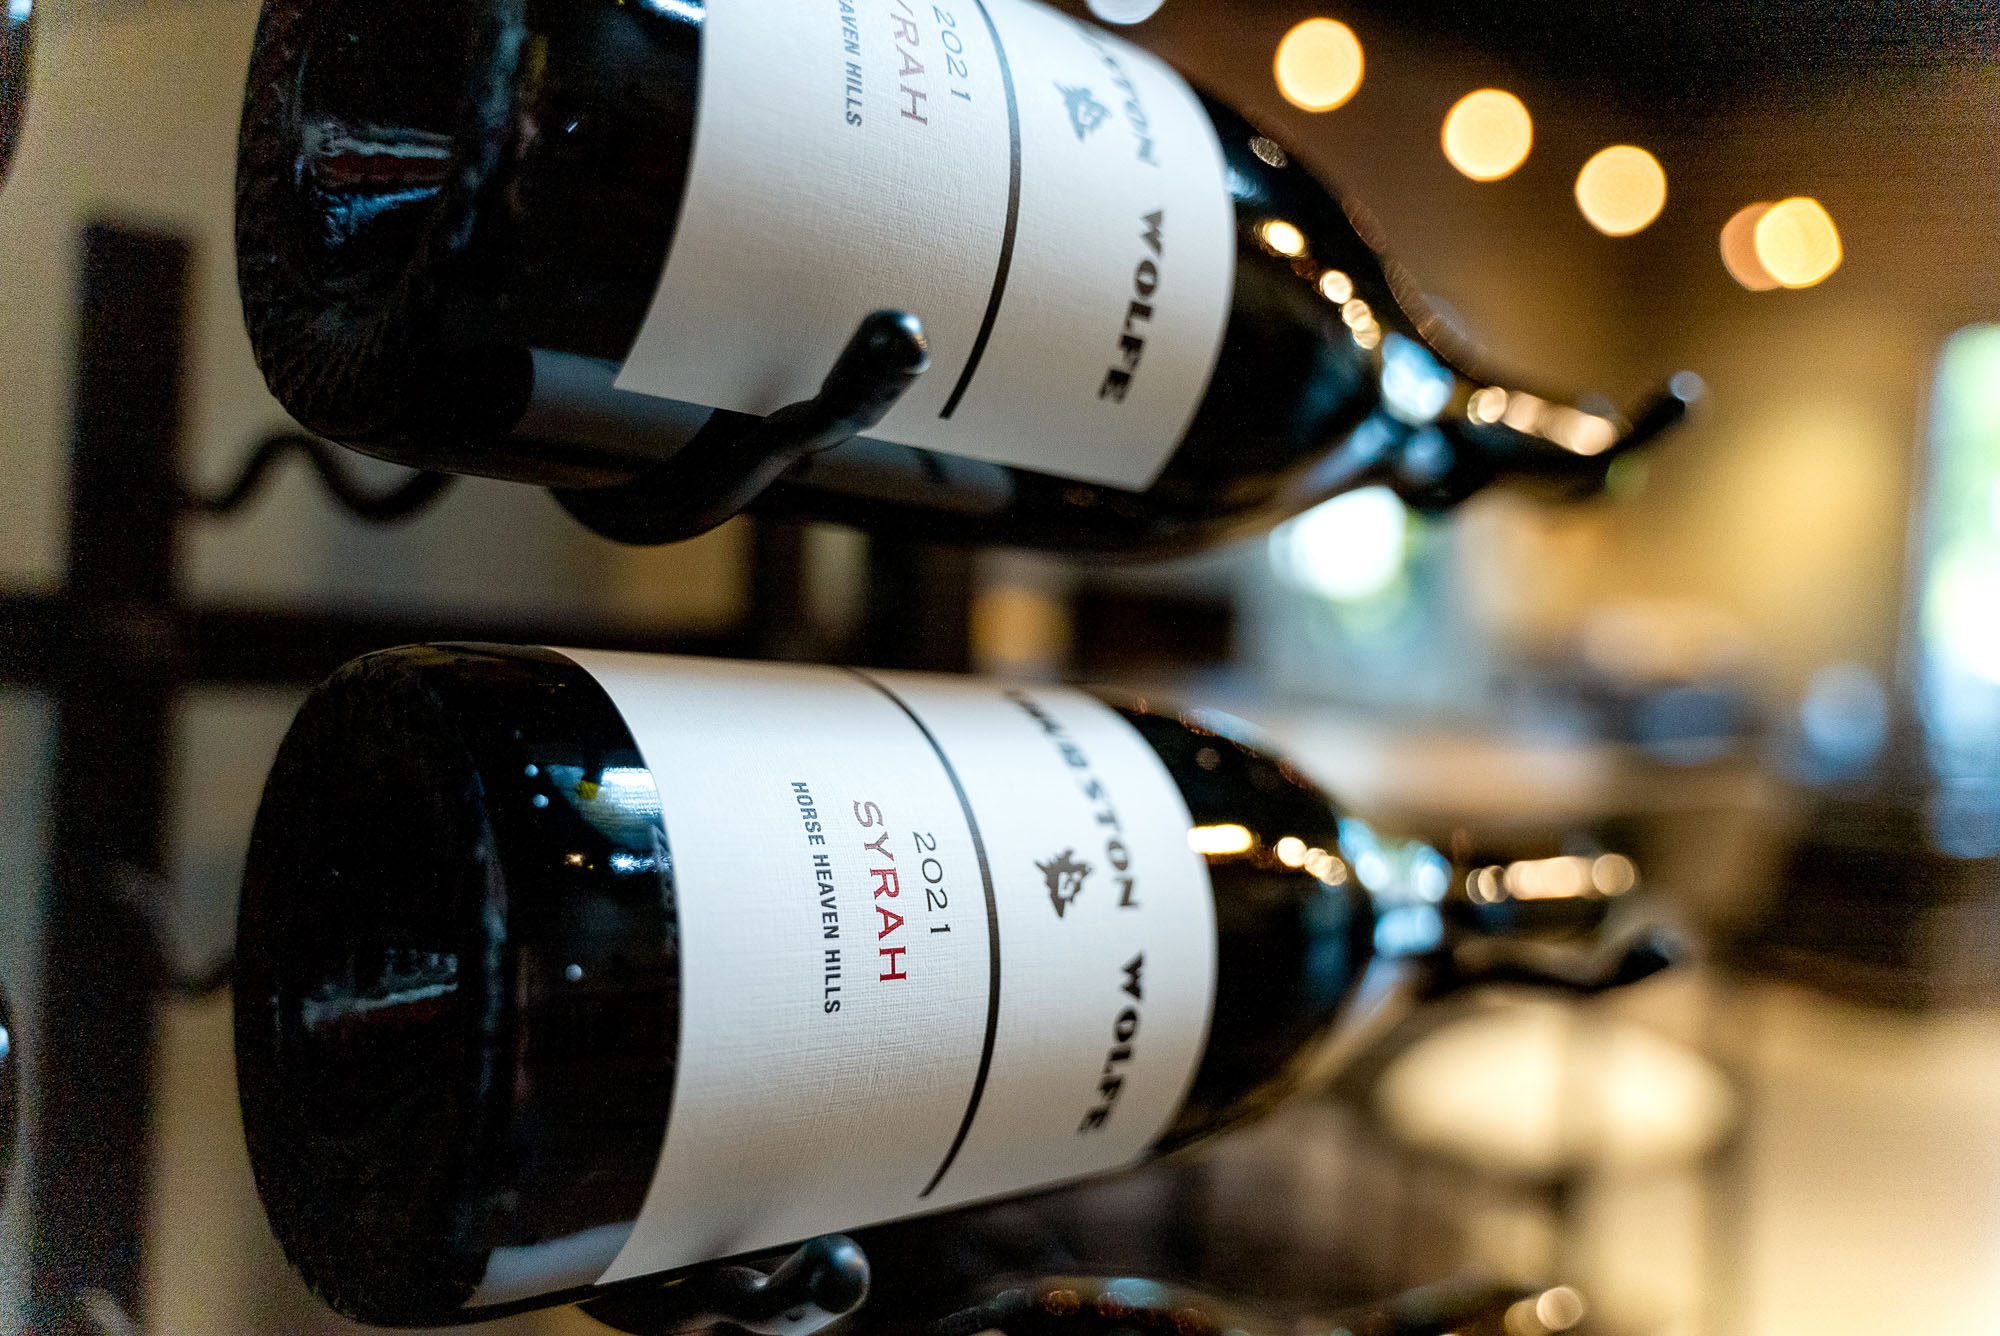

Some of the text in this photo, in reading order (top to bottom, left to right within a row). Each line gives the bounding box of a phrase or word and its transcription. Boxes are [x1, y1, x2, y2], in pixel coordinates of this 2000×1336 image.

[839, 0, 863, 127] AVEN HILLS
[932, 4, 972, 102] 2021
[1099, 209, 1165, 404] WOLFE
[791, 781, 841, 1014] HORSE HEAVEN HILLS
[853, 800, 907, 982] SYRAH
[912, 831, 951, 934] 2021
[1078, 951, 1146, 1134] WOLFE
